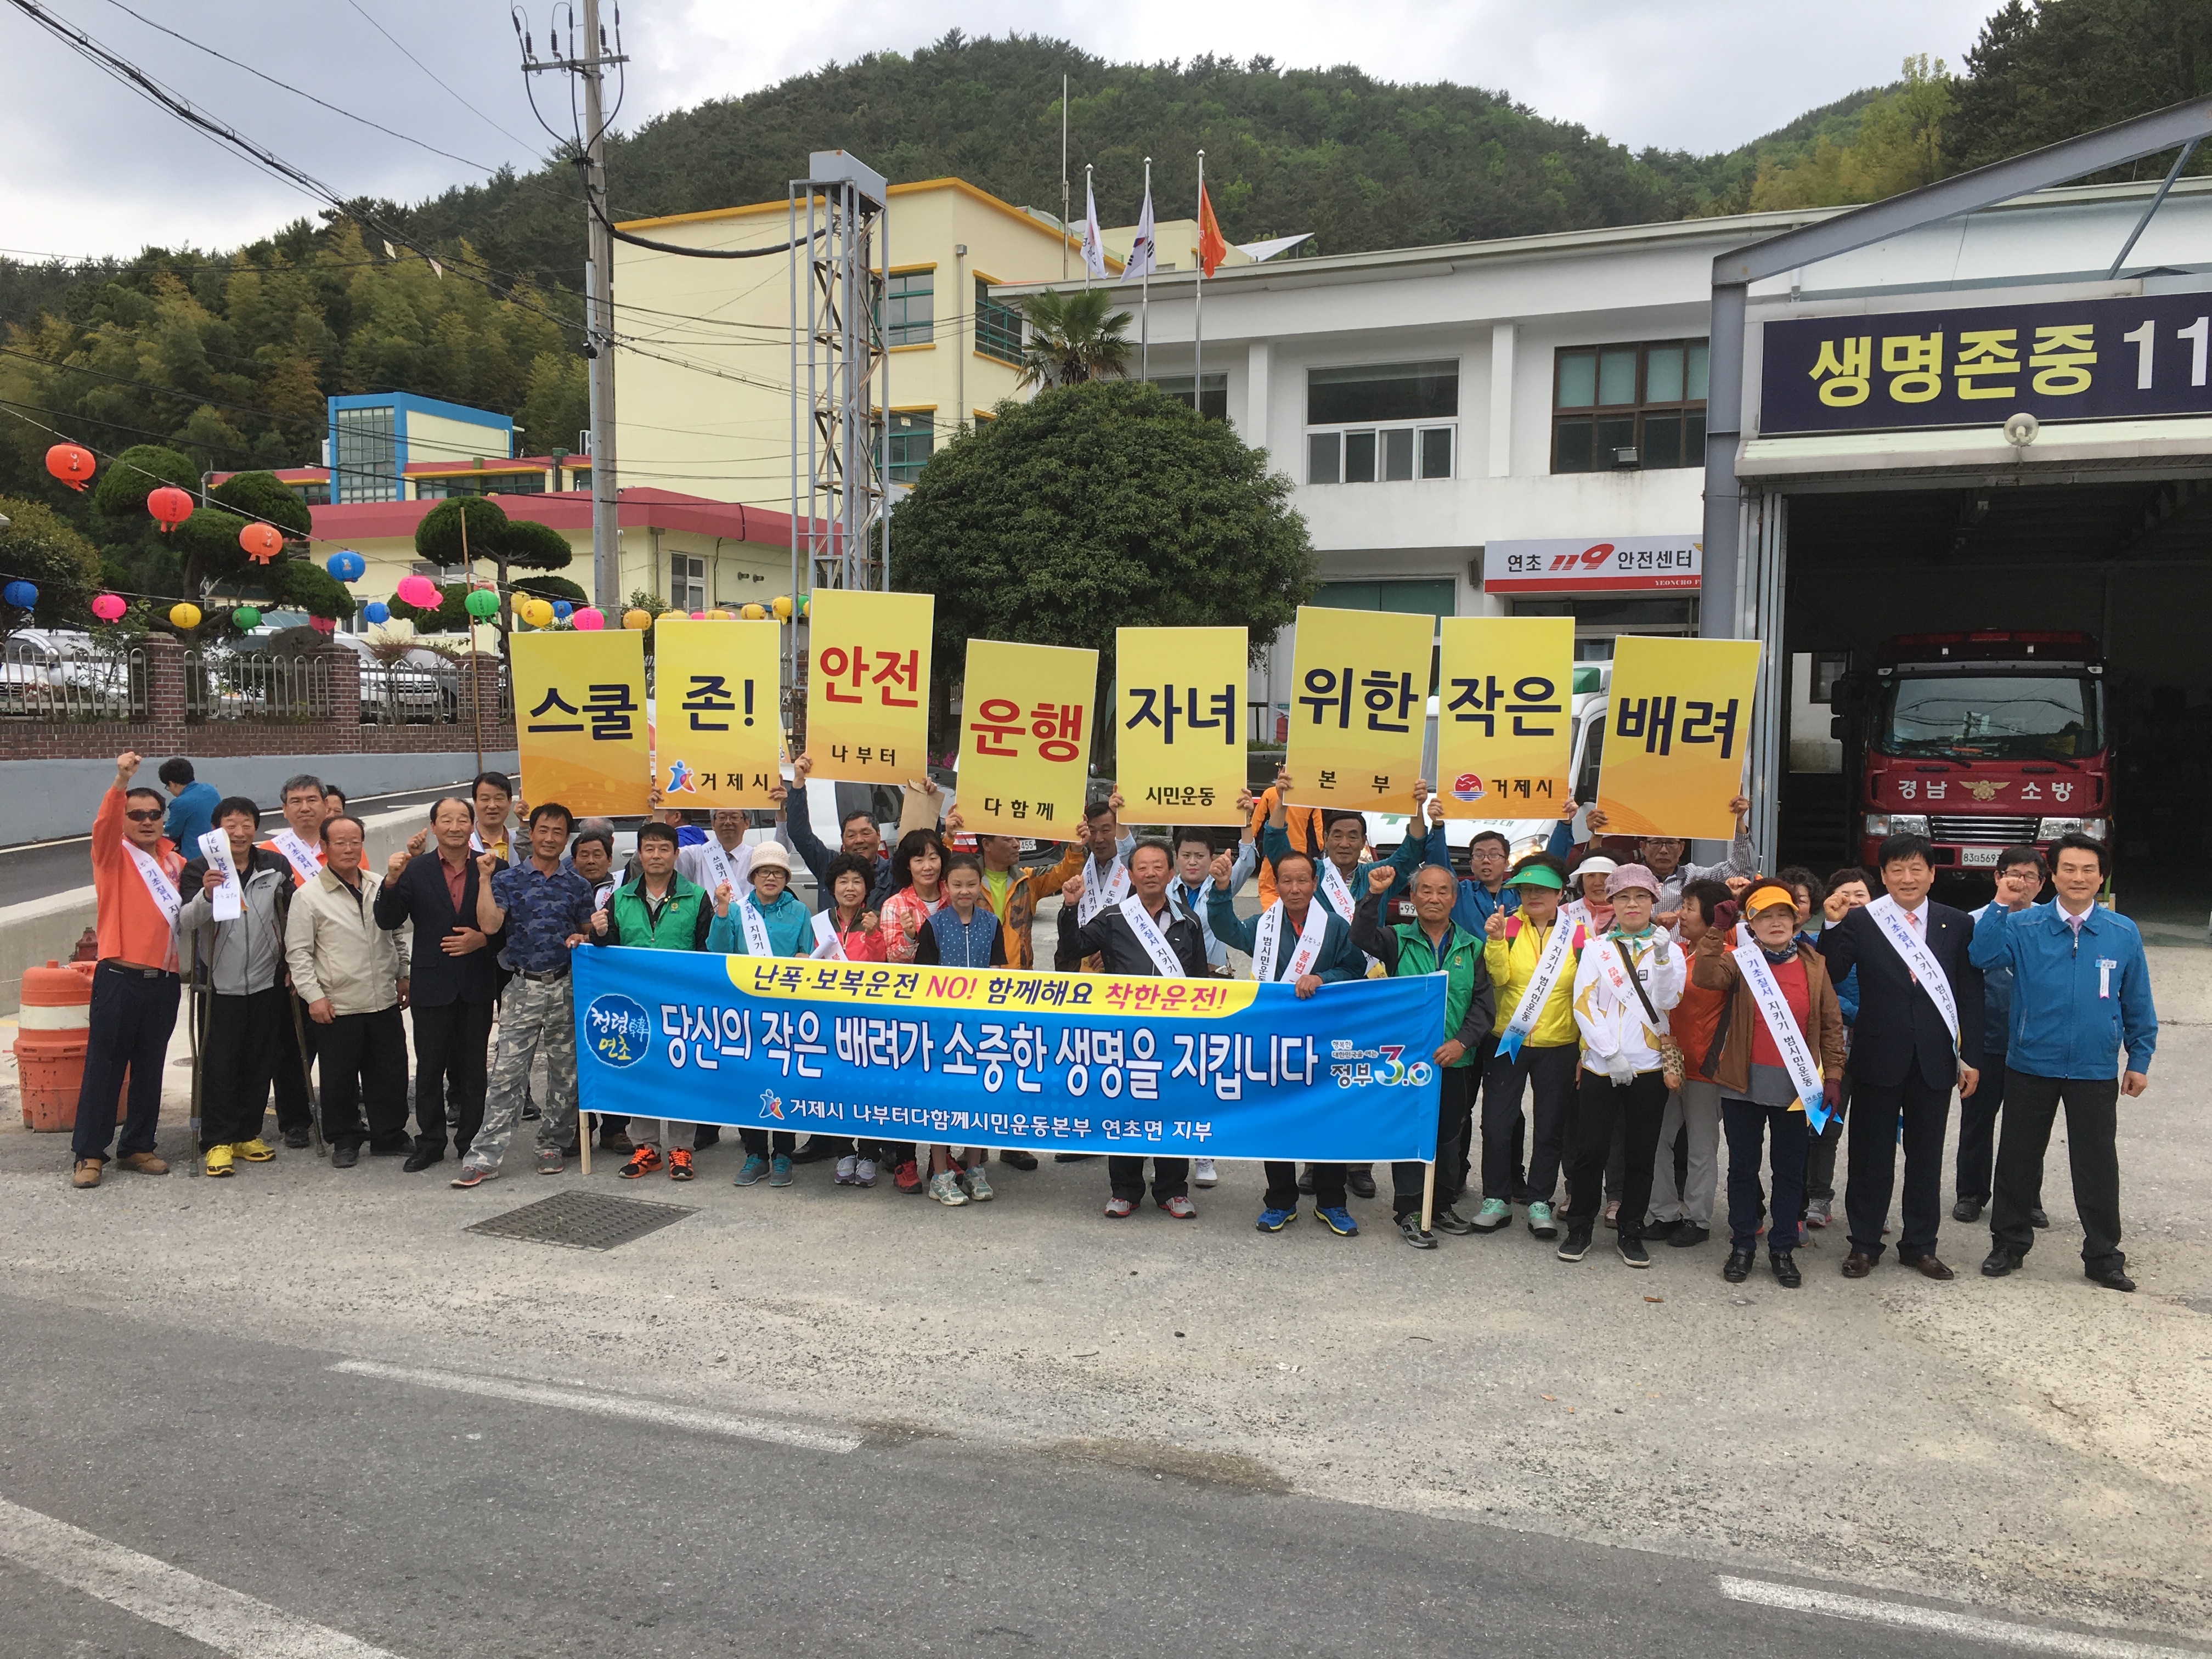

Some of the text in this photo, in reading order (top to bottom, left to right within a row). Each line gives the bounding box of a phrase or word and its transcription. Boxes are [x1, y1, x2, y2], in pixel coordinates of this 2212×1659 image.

[1809, 324, 2098, 408] 생명존중
[1508, 543, 1692, 572] 연초 119 안전센터
[820, 646, 918, 708] 안전
[527, 683, 638, 741] 스쿨
[681, 675, 754, 731] 존!
[1125, 684, 1235, 745] 자녀
[1298, 667, 1419, 733] 위한
[1447, 675, 1562, 738] 작은
[970, 698, 1083, 763] 운행
[1616, 695, 1740, 760] 배려
[832, 744, 896, 767] 나부터
[701, 773, 769, 791] 거제시
[1146, 786, 1216, 807] 시민운동
[1491, 779, 1553, 799] 거제시
[1898, 780, 1948, 800] 경남
[2021, 782, 2074, 802] 소방
[985, 797, 1054, 821] 다함께
[286, 842, 313, 869] 기초질서
[713, 855, 727, 878] 쓰레기
[146, 869, 173, 902] 기초질서
[749, 924, 764, 950] 지키기
[1133, 913, 1178, 973] 기초질서 지키기
[1884, 913, 1916, 950] 기초질서
[1912, 951, 1938, 980] 지키기
[1545, 945, 1562, 974] 지키기
[926, 975, 978, 1000] NO!
[988, 977, 1093, 1006] 함께해요
[1105, 983, 1227, 1012] 착한운전!
[1521, 975, 1549, 1022] 범시민운동
[1747, 958, 1813, 1087] 기초질서 지키기 범시민운동
[599, 1034, 632, 1060] 연초
[660, 1003, 1319, 1102] 당신의 작은 배려가 소중한 생명을 지킵니다
[1332, 1040, 1352, 1049] 행복한
[1332, 1051, 1363, 1059] 대한민국을
[789, 1098, 1213, 1143] 거제시 나부터다함께시민운동본부 연초면 지부
